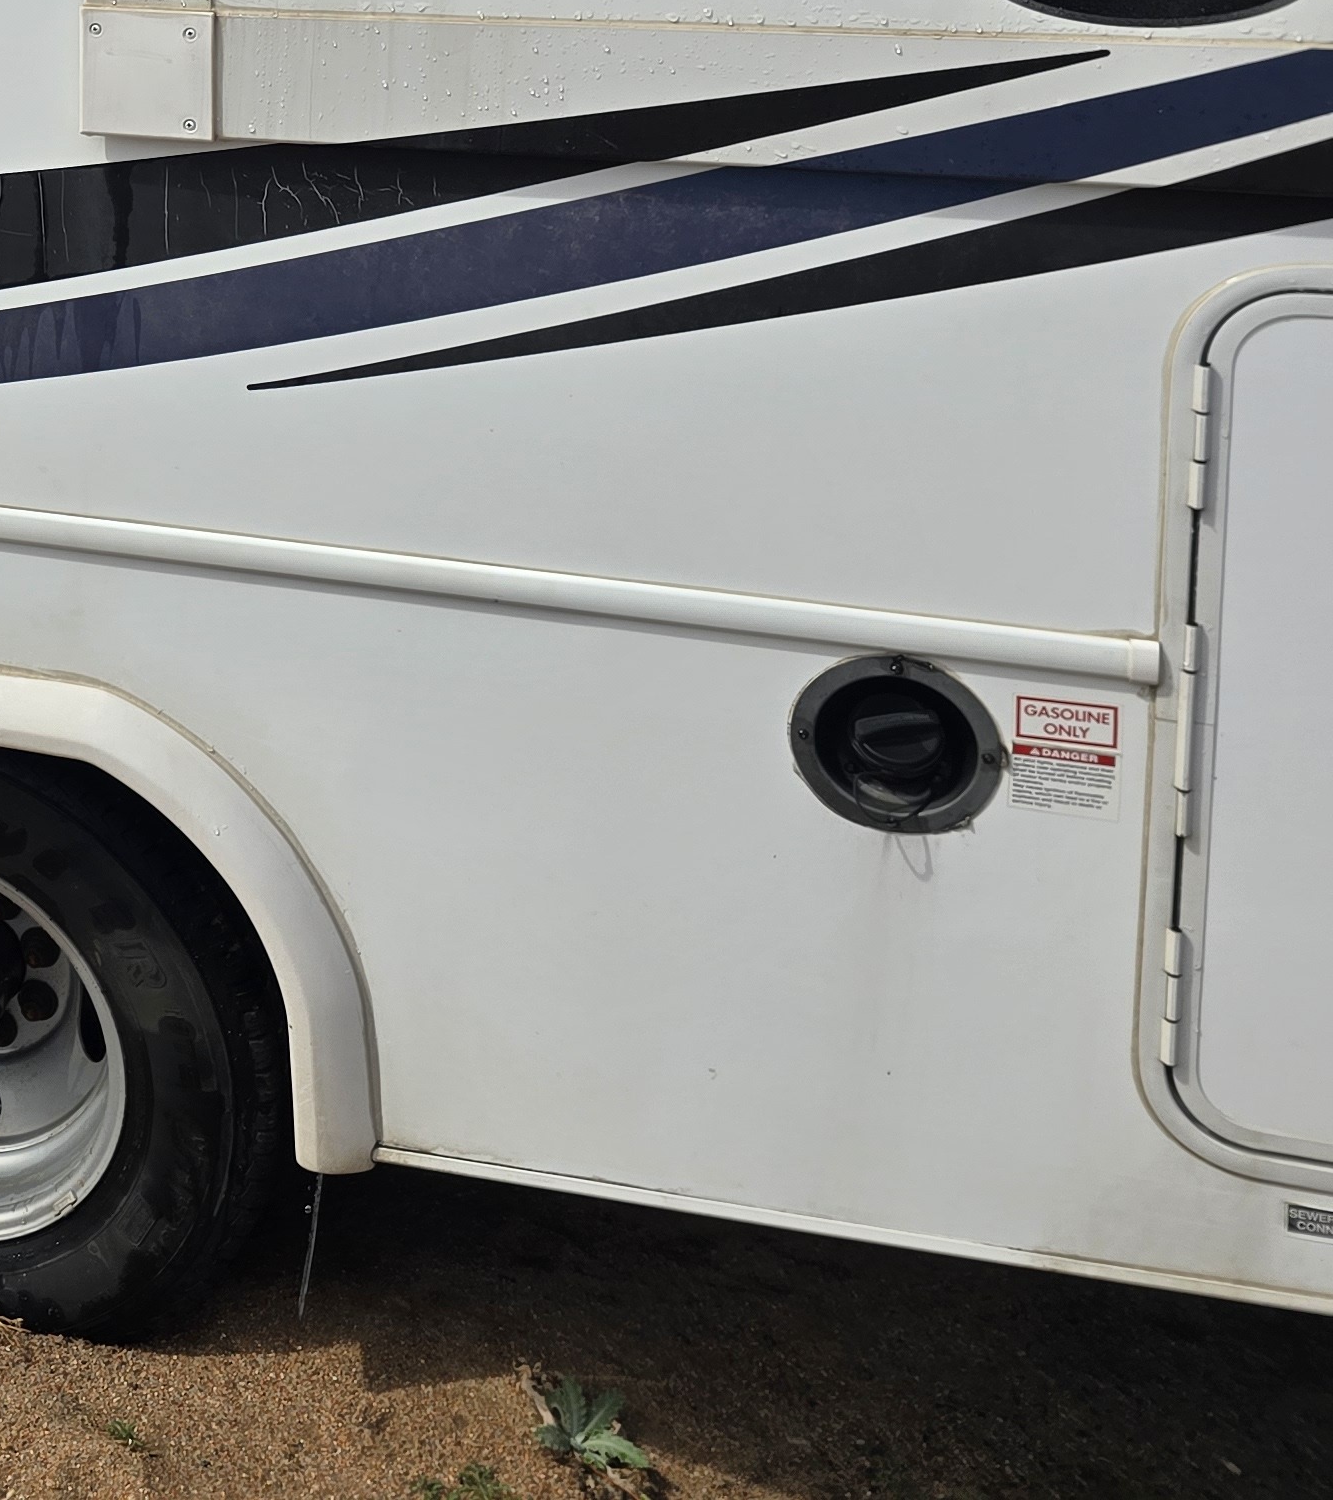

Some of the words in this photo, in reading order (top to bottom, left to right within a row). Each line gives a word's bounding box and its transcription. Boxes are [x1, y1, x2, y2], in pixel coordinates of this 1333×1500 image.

[1024, 704, 1110, 725] GASOLINE
[1043, 722, 1090, 739] ONLY
[1041, 747, 1099, 763] DANGER
